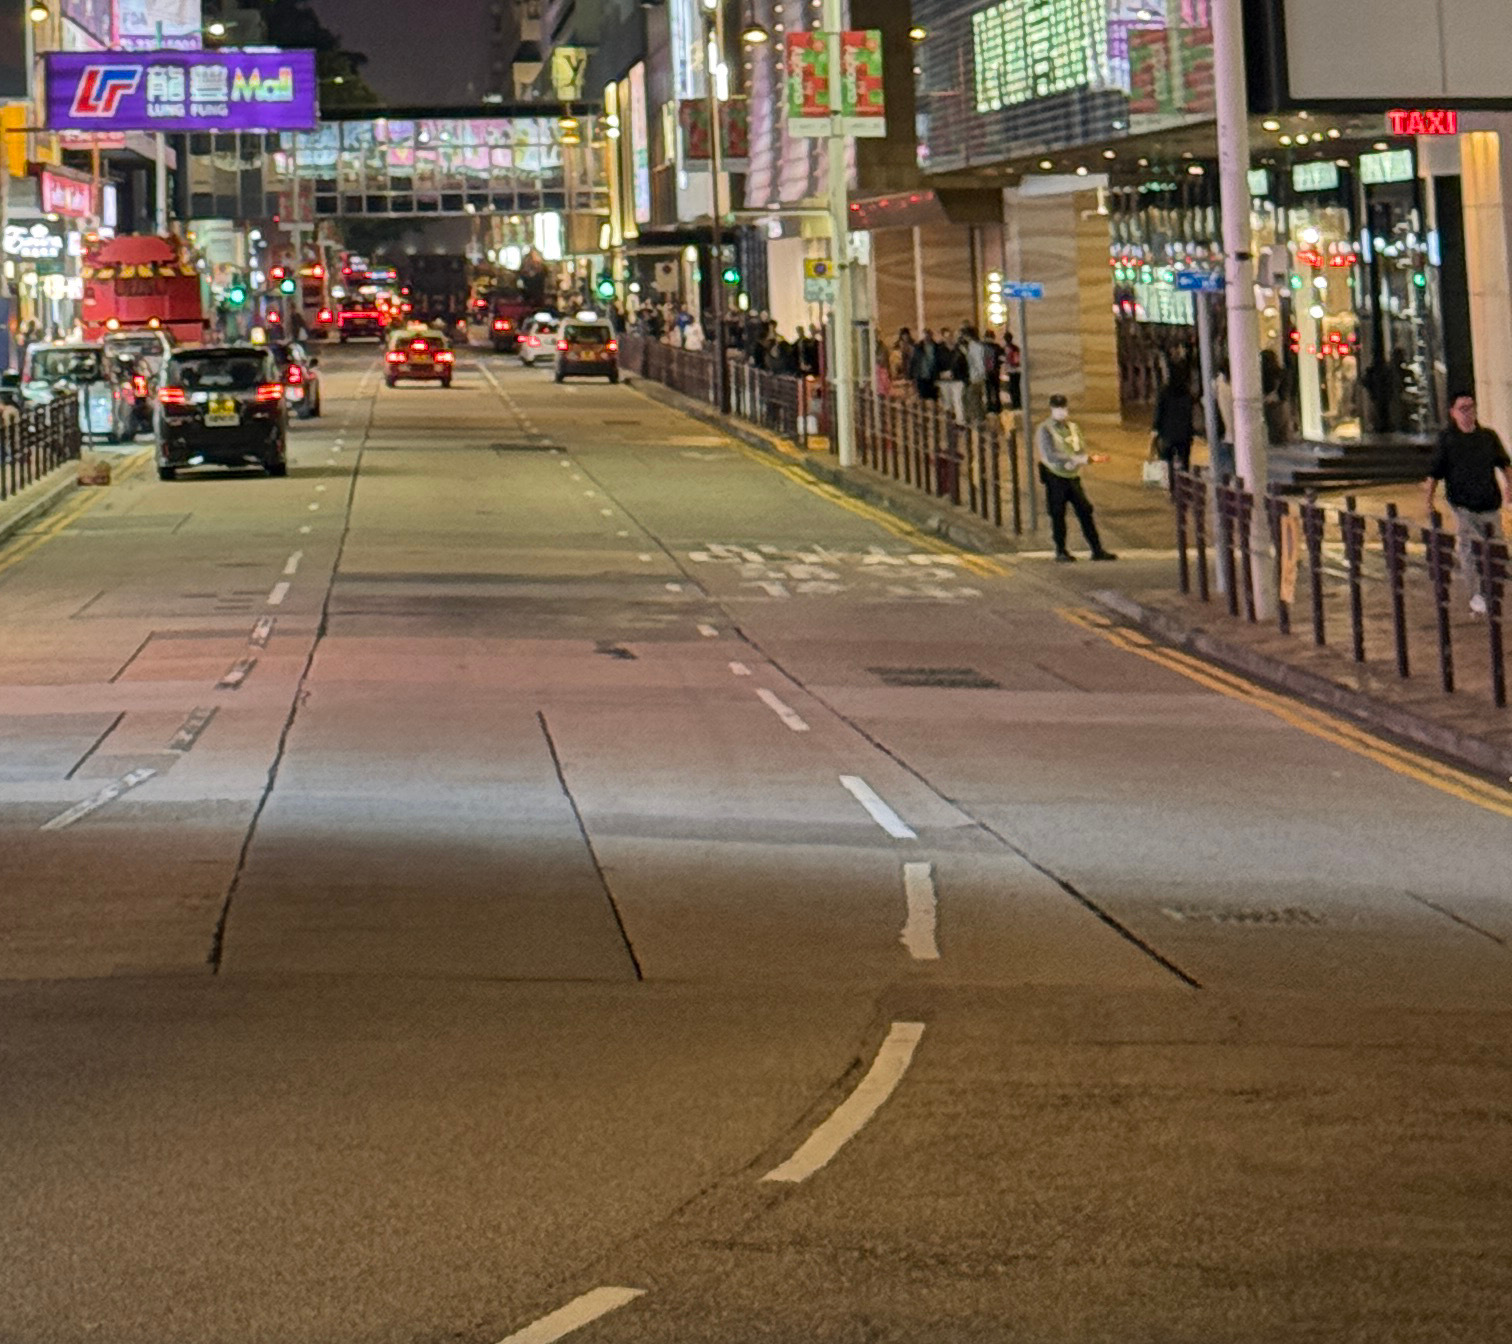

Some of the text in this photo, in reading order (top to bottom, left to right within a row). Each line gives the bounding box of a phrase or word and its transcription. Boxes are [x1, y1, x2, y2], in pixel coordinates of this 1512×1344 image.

[146, 64, 295, 103] 龍豐 Mall
[146, 103, 229, 118] LUNG FUNG
[1387, 109, 1457, 135] TAXI
